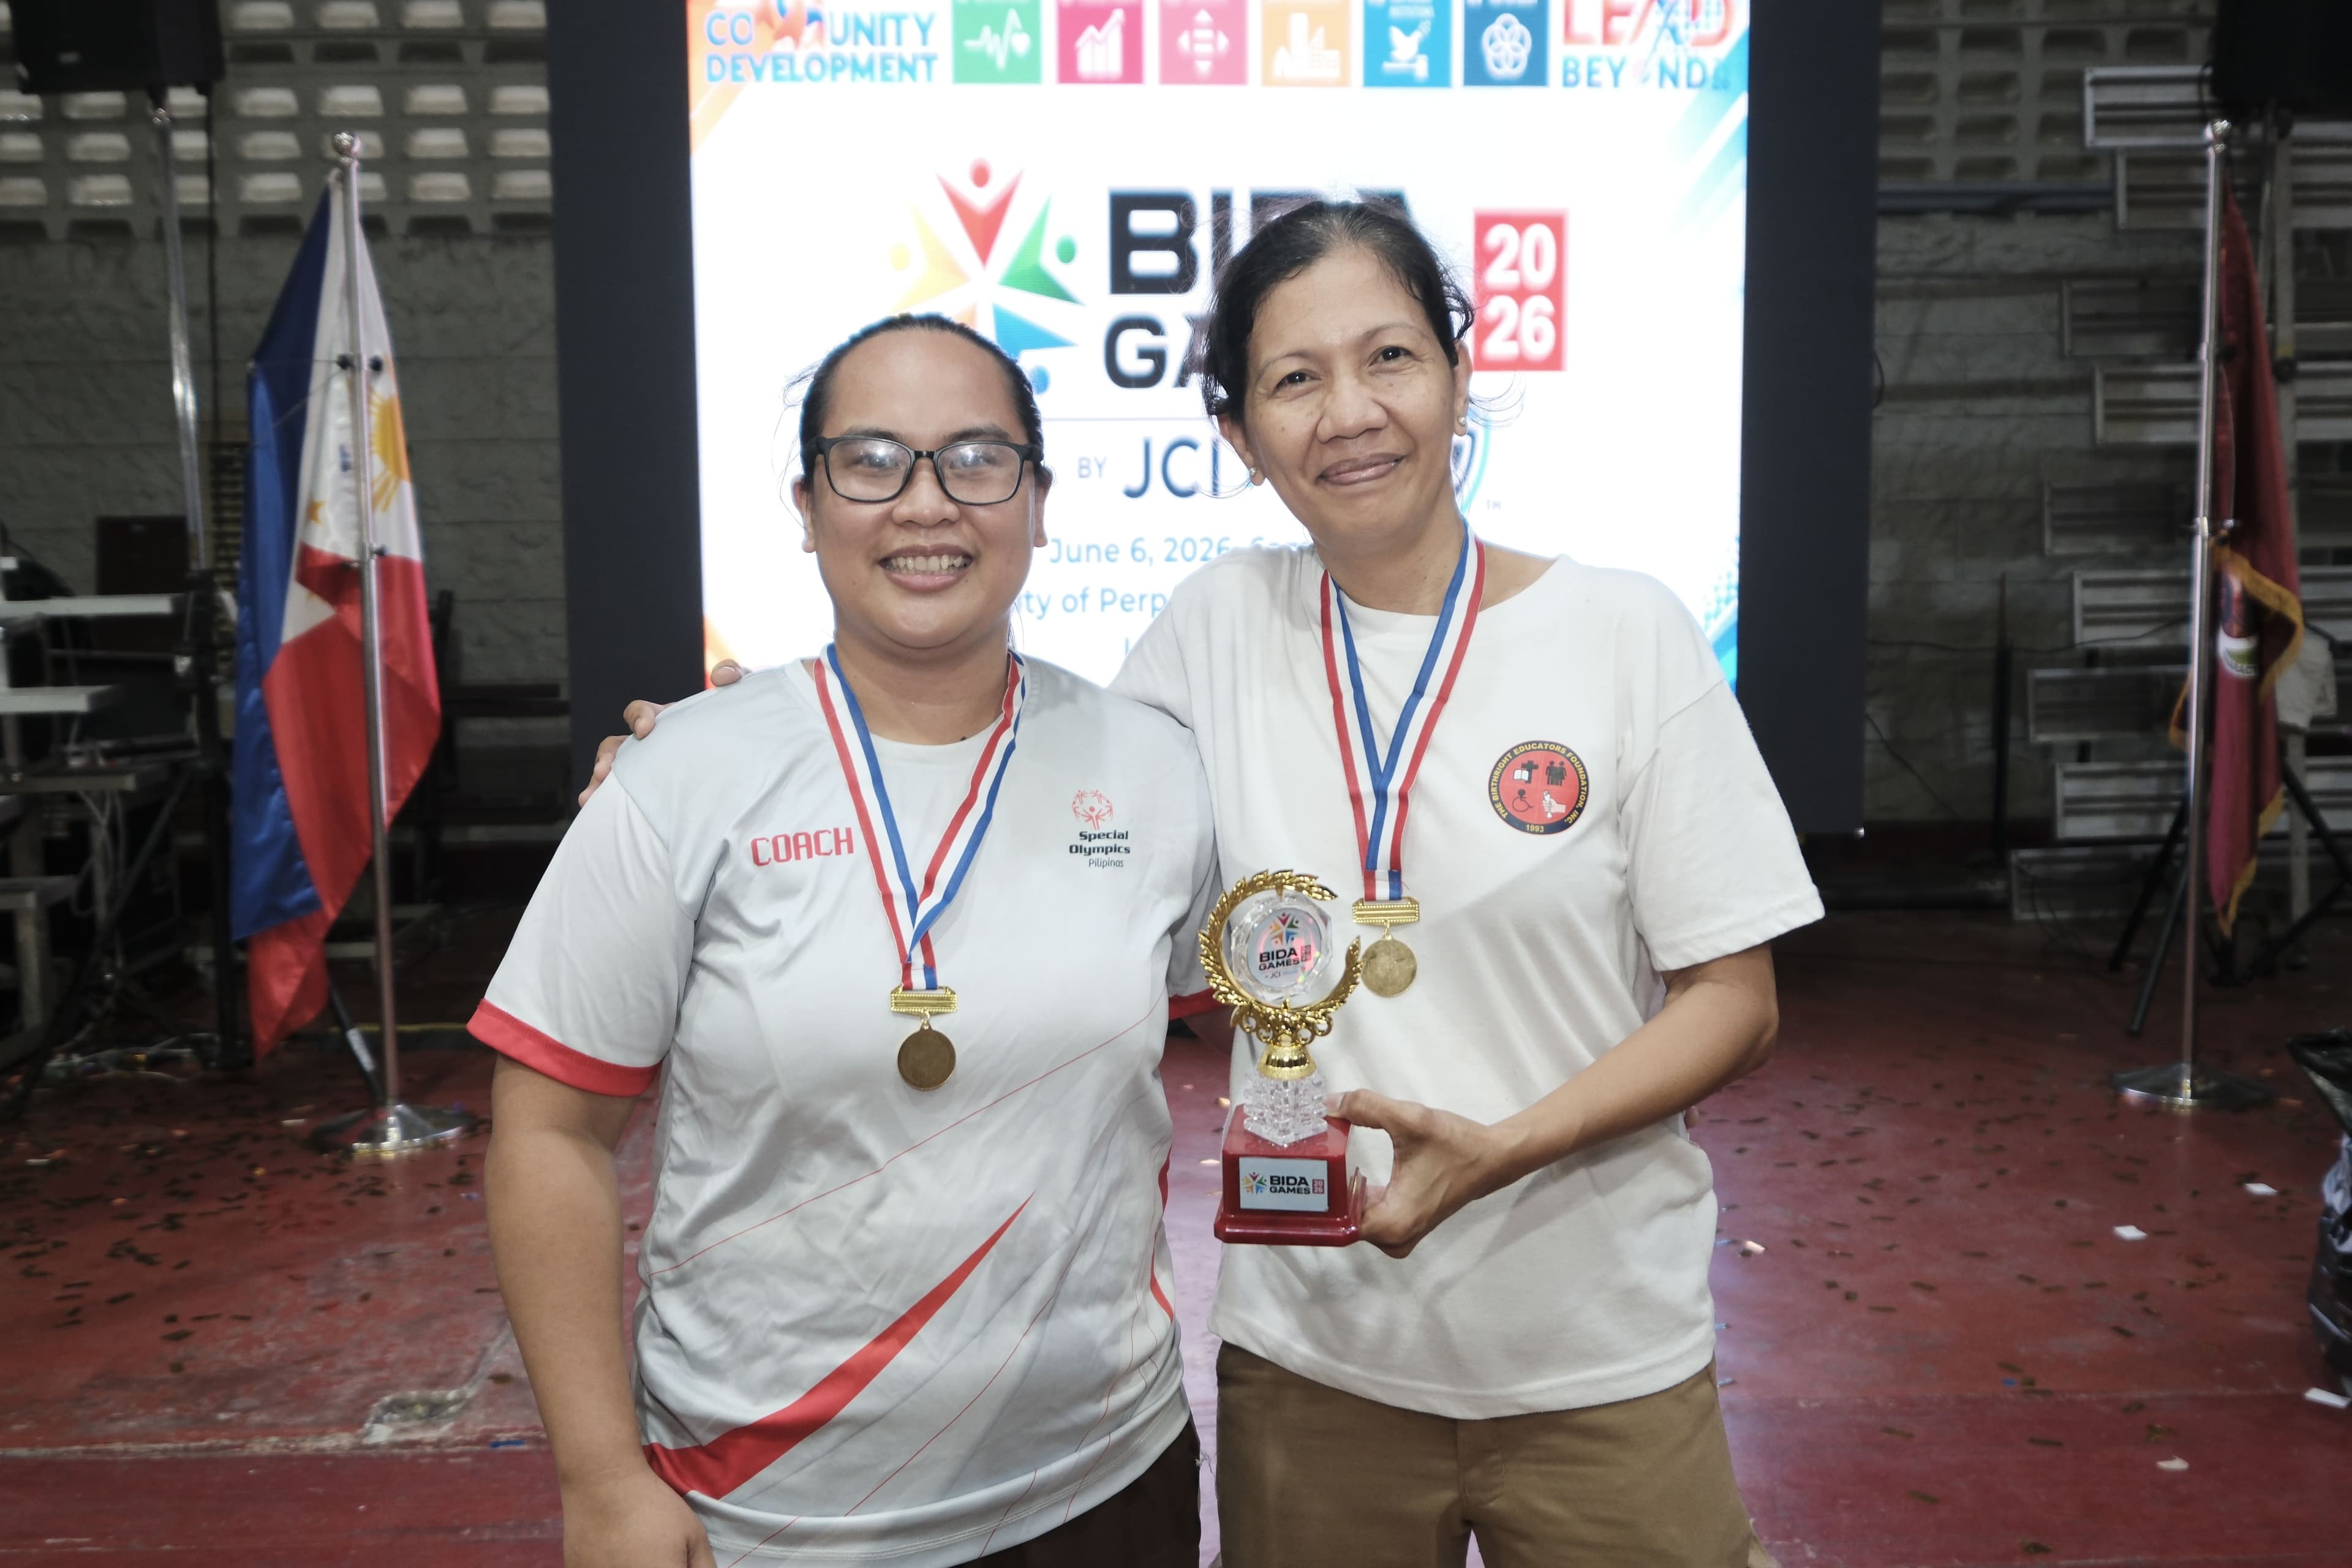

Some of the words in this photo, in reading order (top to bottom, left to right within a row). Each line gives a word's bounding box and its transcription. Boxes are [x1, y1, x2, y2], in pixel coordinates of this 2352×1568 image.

[706, 12, 936, 47] COUNITY
[706, 52, 938, 83] DEVELOPMENT
[1483, 222, 1557, 290] 20
[1482, 295, 1556, 361] 26
[1077, 457, 1107, 478] BY
[1123, 436, 1220, 499] JCI
[1049, 538, 1120, 564] June
[1131, 537, 1153, 567] 6,
[1061, 586, 1090, 613] of
[1513, 742, 1567, 755] EDUCATORS
[1491, 752, 1513, 801] BIRTHRIGHT
[1566, 752, 1588, 809] FOUNDATION,
[1494, 802, 1508, 819] THE
[1564, 810, 1579, 824] INC.
[1079, 830, 1129, 842] Special
[1526, 824, 1544, 832] 1993
[750, 827, 854, 867] COACH
[1069, 844, 1131, 856] Olympics
[1088, 858, 1125, 869] Pilipinas
[1259, 947, 1298, 962] BIDA
[1259, 958, 1300, 971] GAMES
[1270, 1175, 1309, 1186] BIDA
[1270, 1186, 1311, 1194] GAMES
